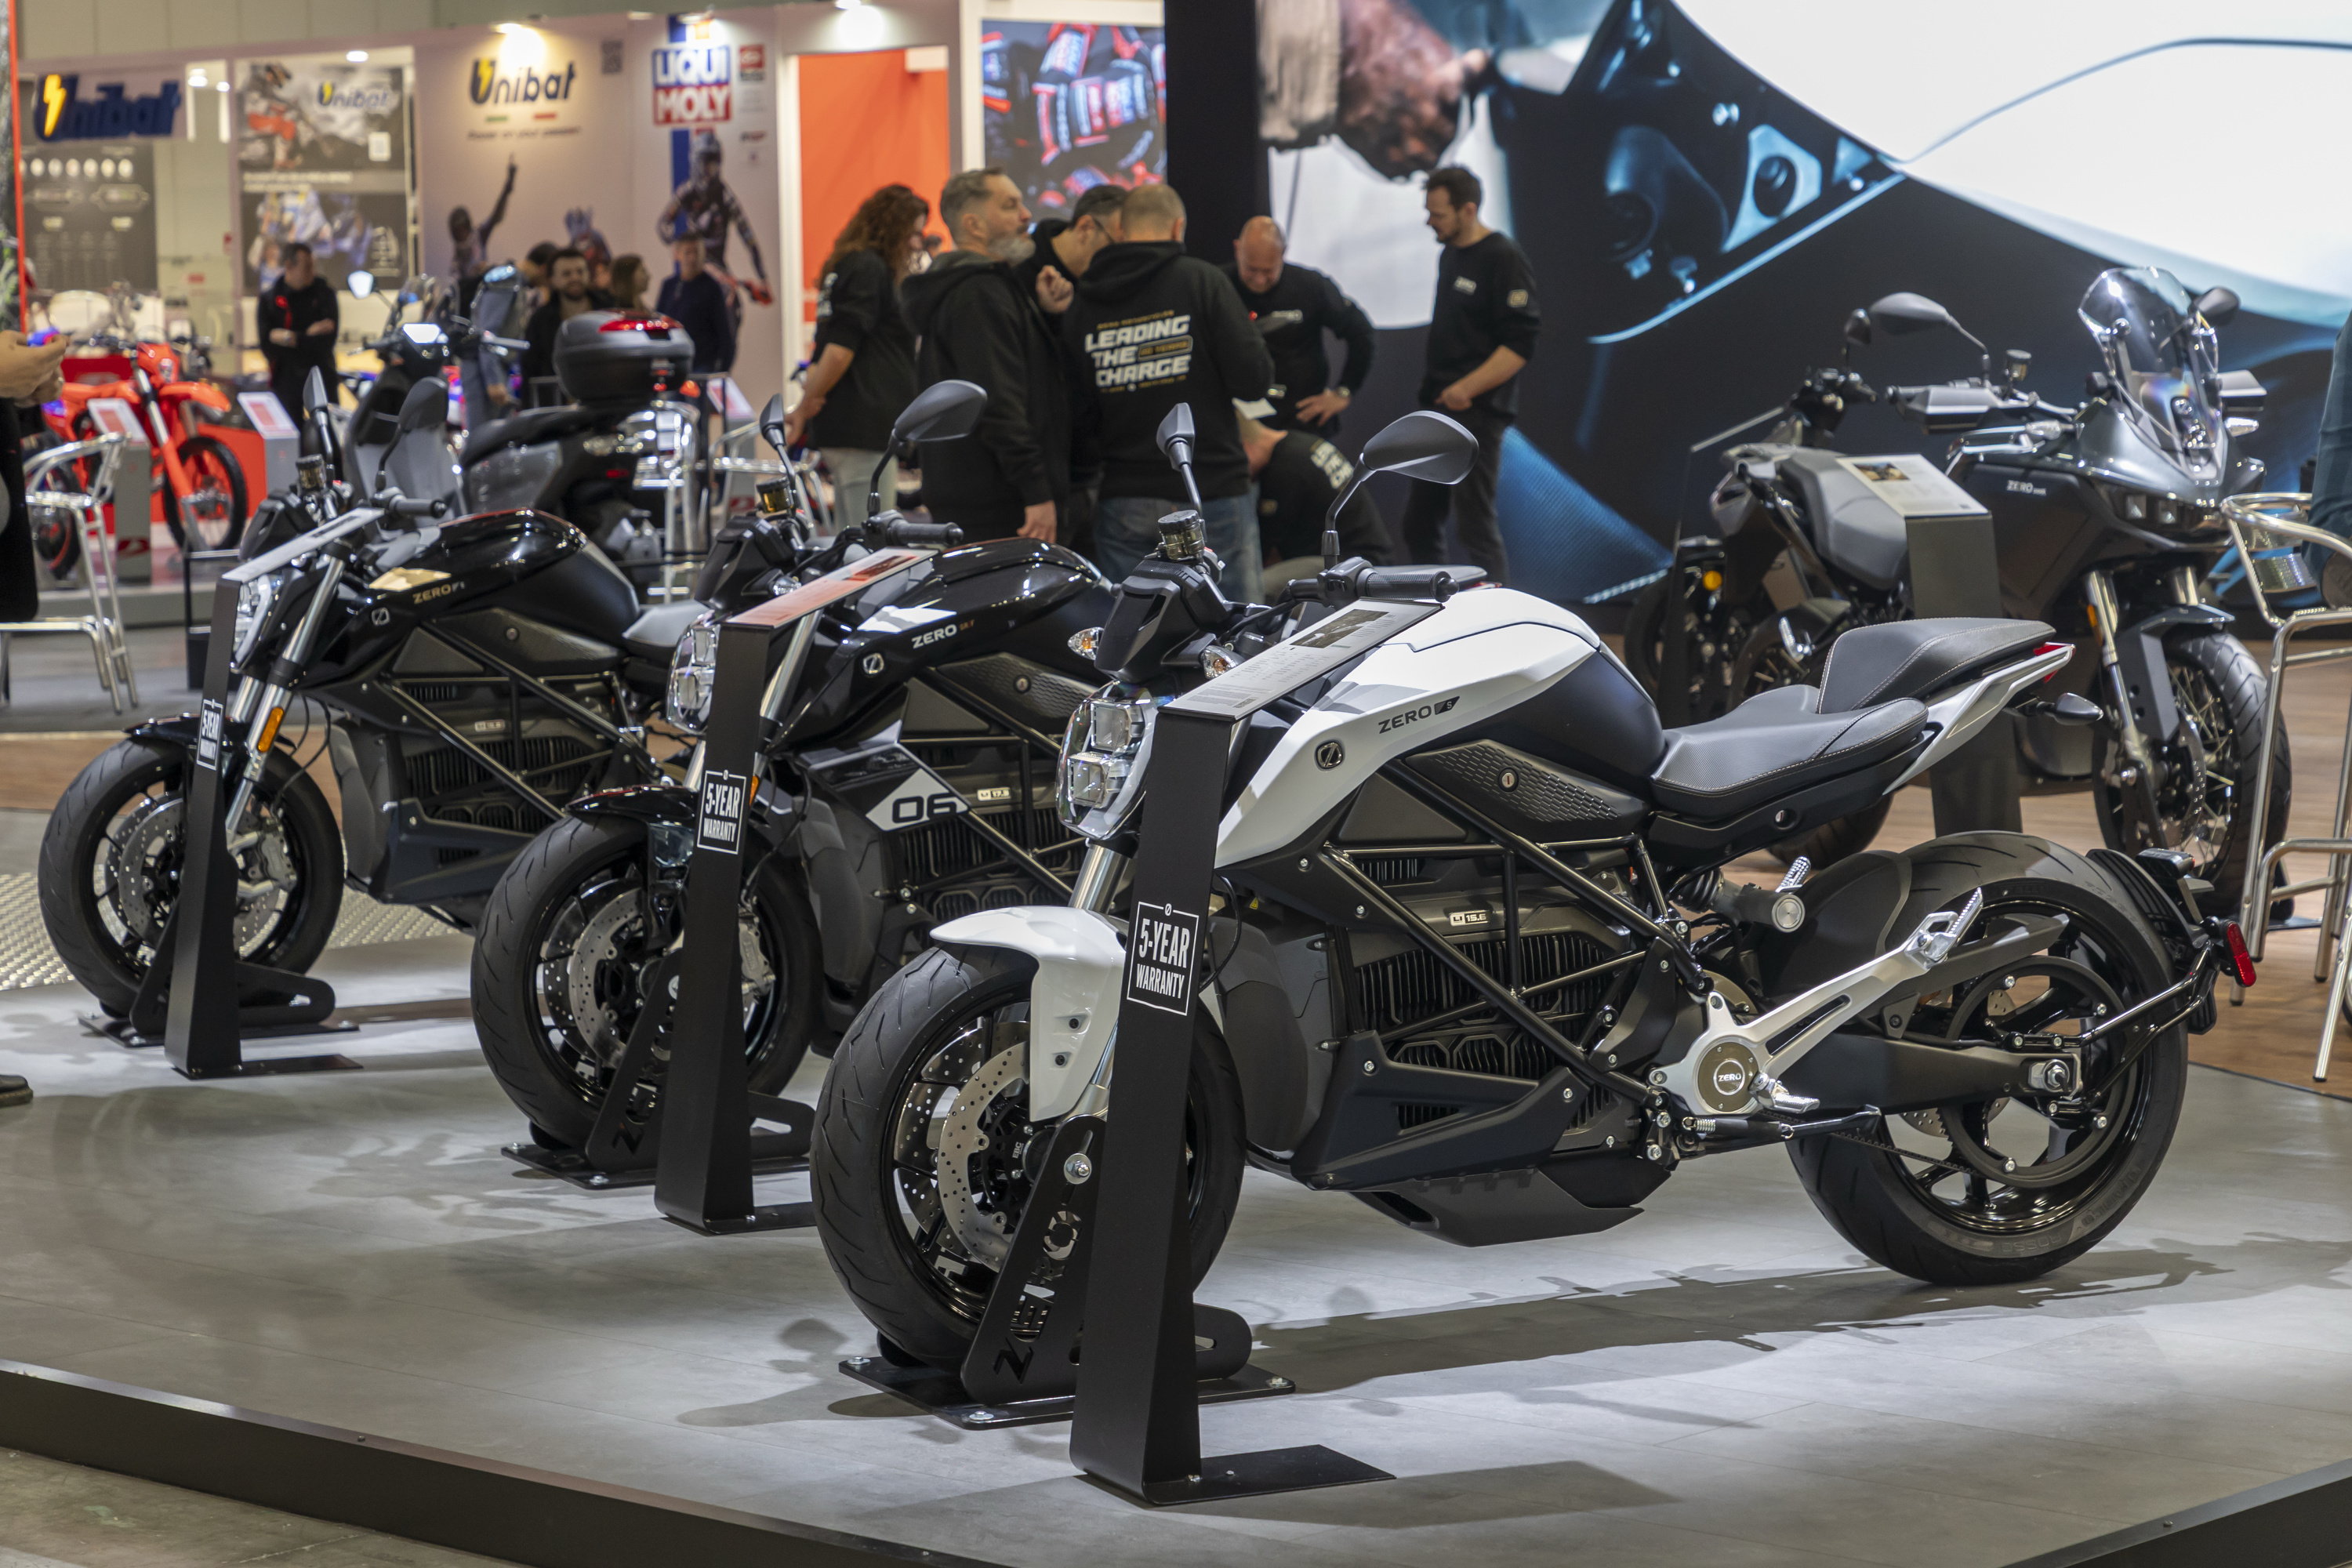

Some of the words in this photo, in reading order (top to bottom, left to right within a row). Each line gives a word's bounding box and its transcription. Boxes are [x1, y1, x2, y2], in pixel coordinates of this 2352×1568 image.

[656, 48, 728, 84] LIQUI
[471, 60, 576, 104] Unibat
[656, 85, 731, 122] MOLY
[1084, 314, 1191, 353] LEADING
[1091, 345, 1138, 368] THE
[1096, 354, 1192, 387] CHARGE
[2006, 479, 2034, 494] ZERO
[412, 583, 452, 604] ZERO
[911, 624, 957, 649] ZERO
[1377, 705, 1432, 734] ZERO
[705, 782, 741, 818] 5-YEAR
[892, 792, 957, 824] 06
[703, 817, 737, 843] WARRANTY
[1465, 913, 1487, 922] 15.6
[1138, 917, 1190, 969] 5-YEAR
[1136, 963, 1185, 1000] WARRANTY
[1718, 1073, 1742, 1082] ZERO
[1011, 1142, 1022, 1159] EBC
[2001, 1234, 2062, 1253] ROSSO
